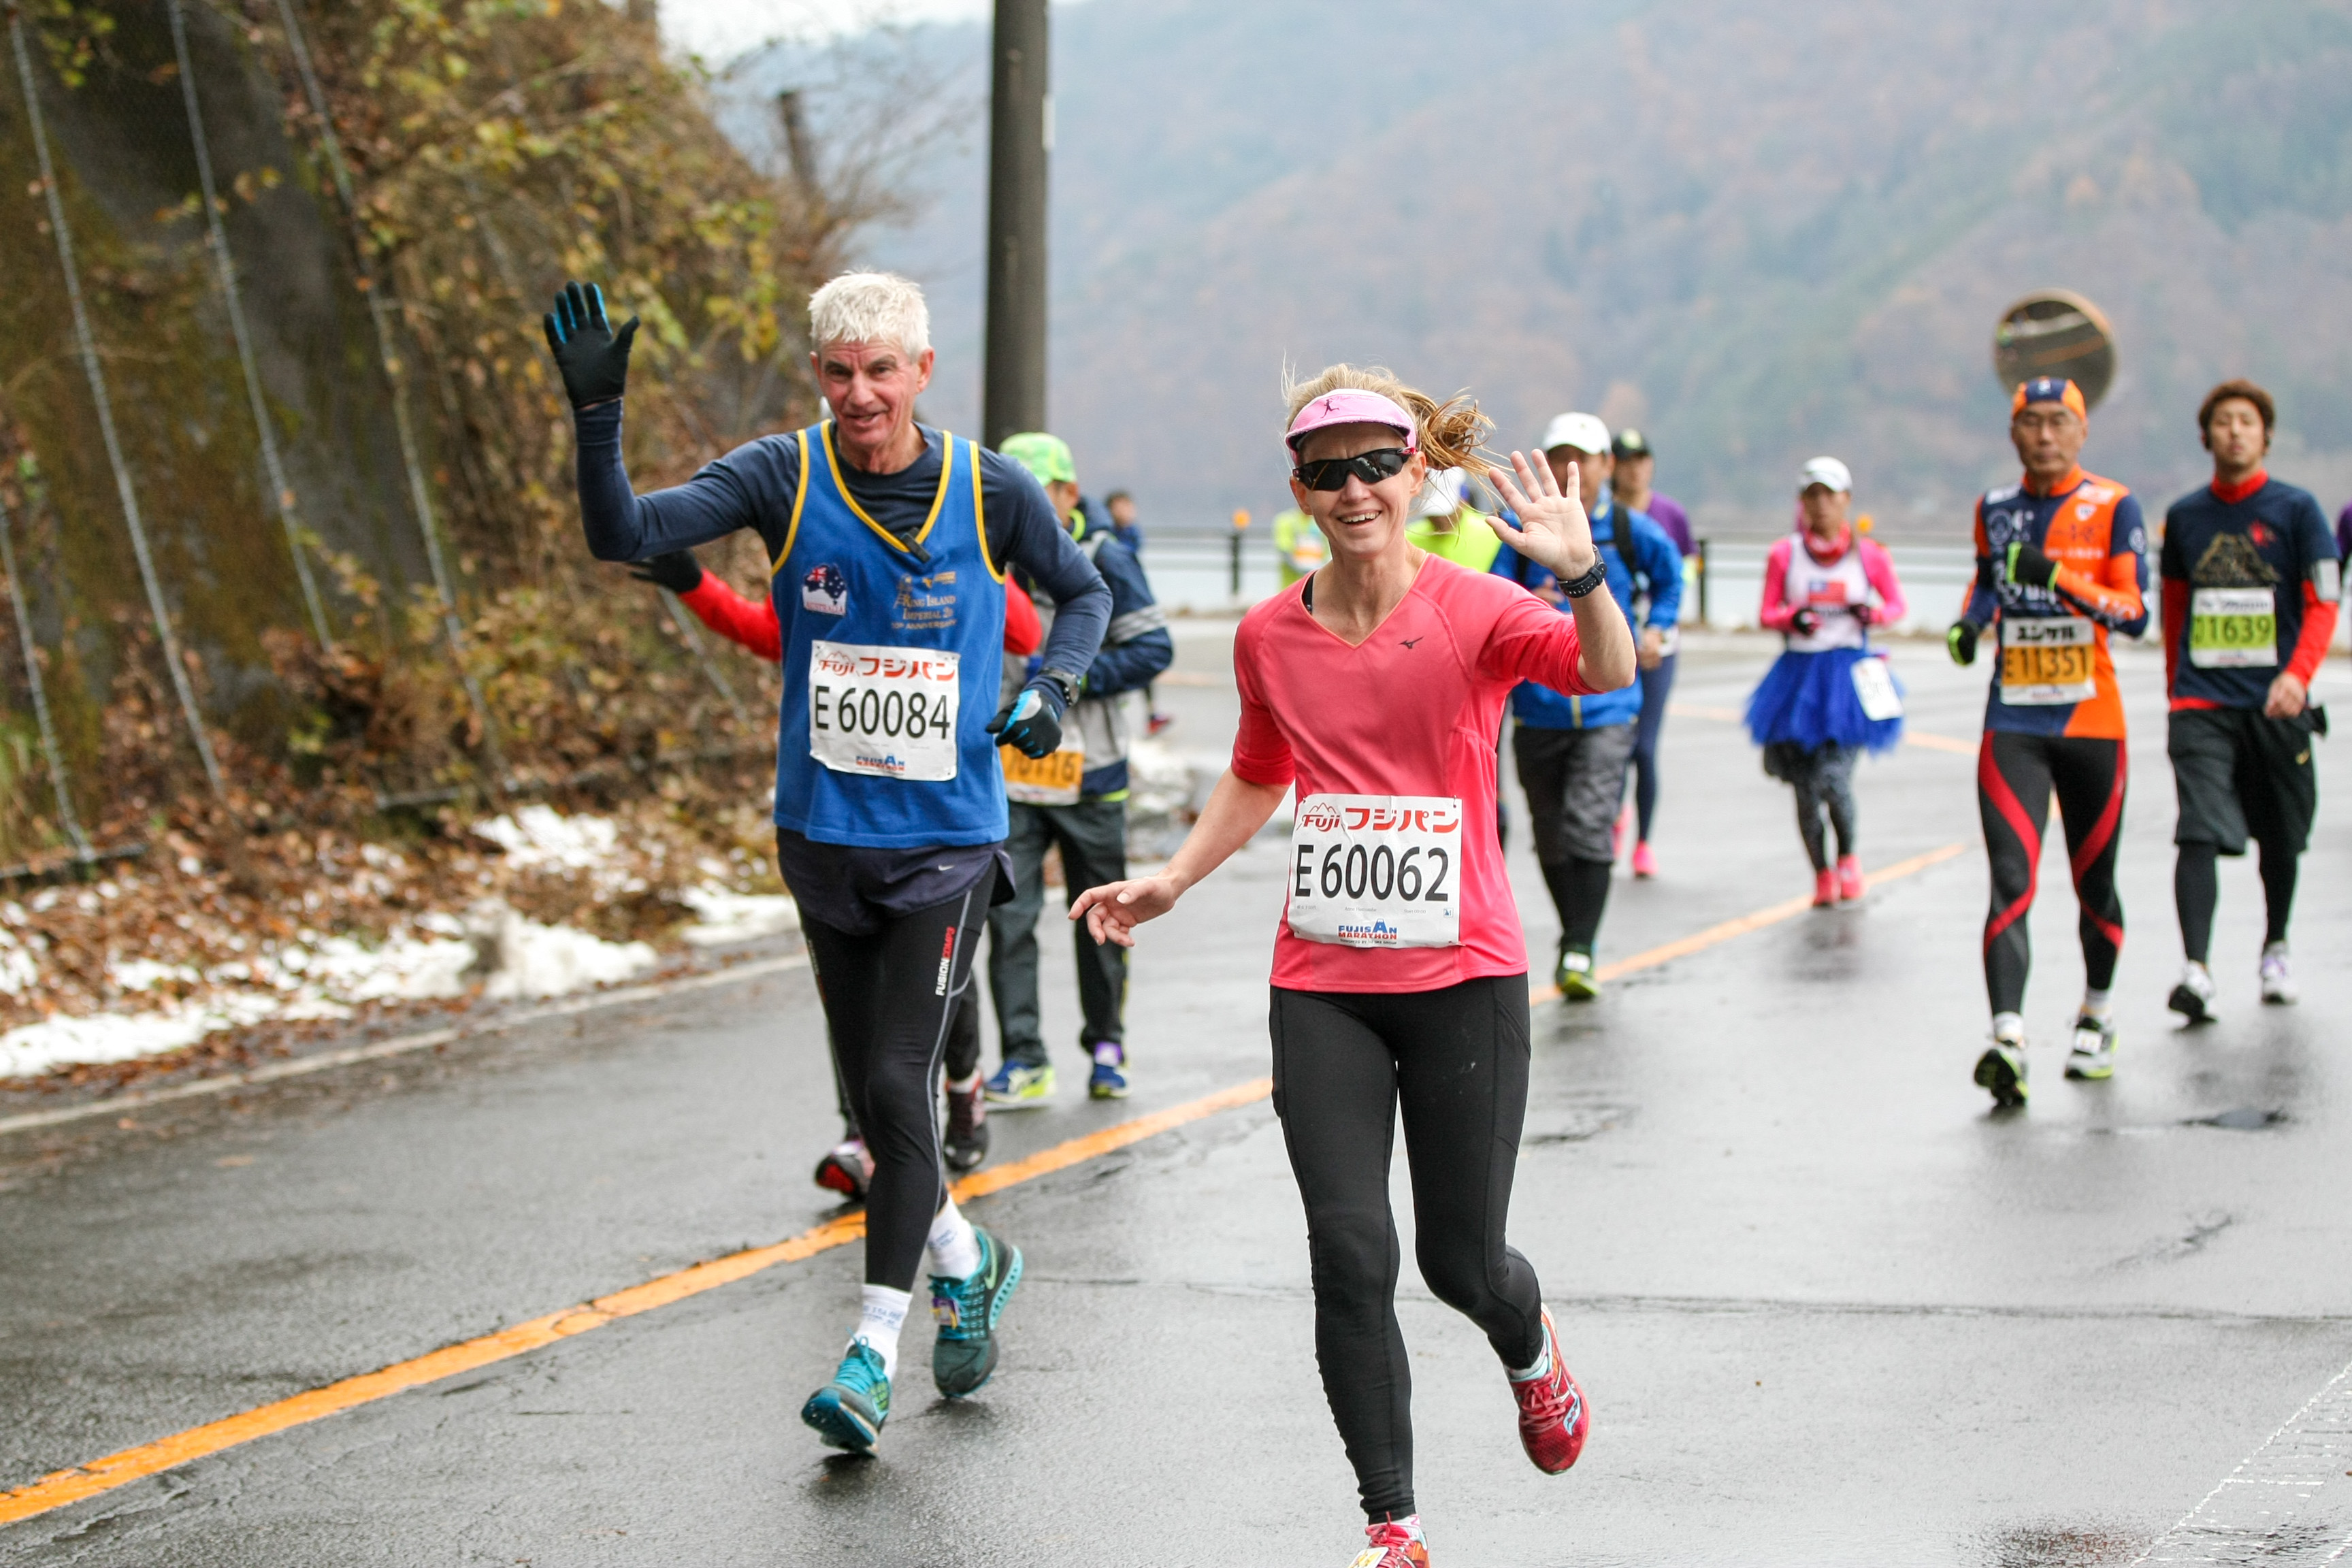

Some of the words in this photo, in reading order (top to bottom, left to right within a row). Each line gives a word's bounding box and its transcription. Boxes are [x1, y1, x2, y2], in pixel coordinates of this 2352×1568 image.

[819, 659, 855, 676] Fuji
[860, 657, 956, 681] フジパン
[815, 685, 951, 740] E60084
[856, 753, 904, 766] FUJISAN
[856, 760, 905, 772] MARATHON
[1302, 814, 1341, 832] Fuji
[1345, 807, 1459, 833] フジパン
[1294, 843, 1449, 902] E60062
[1338, 918, 1397, 934] FUJISAN
[1338, 932, 1397, 940] MARATHON
